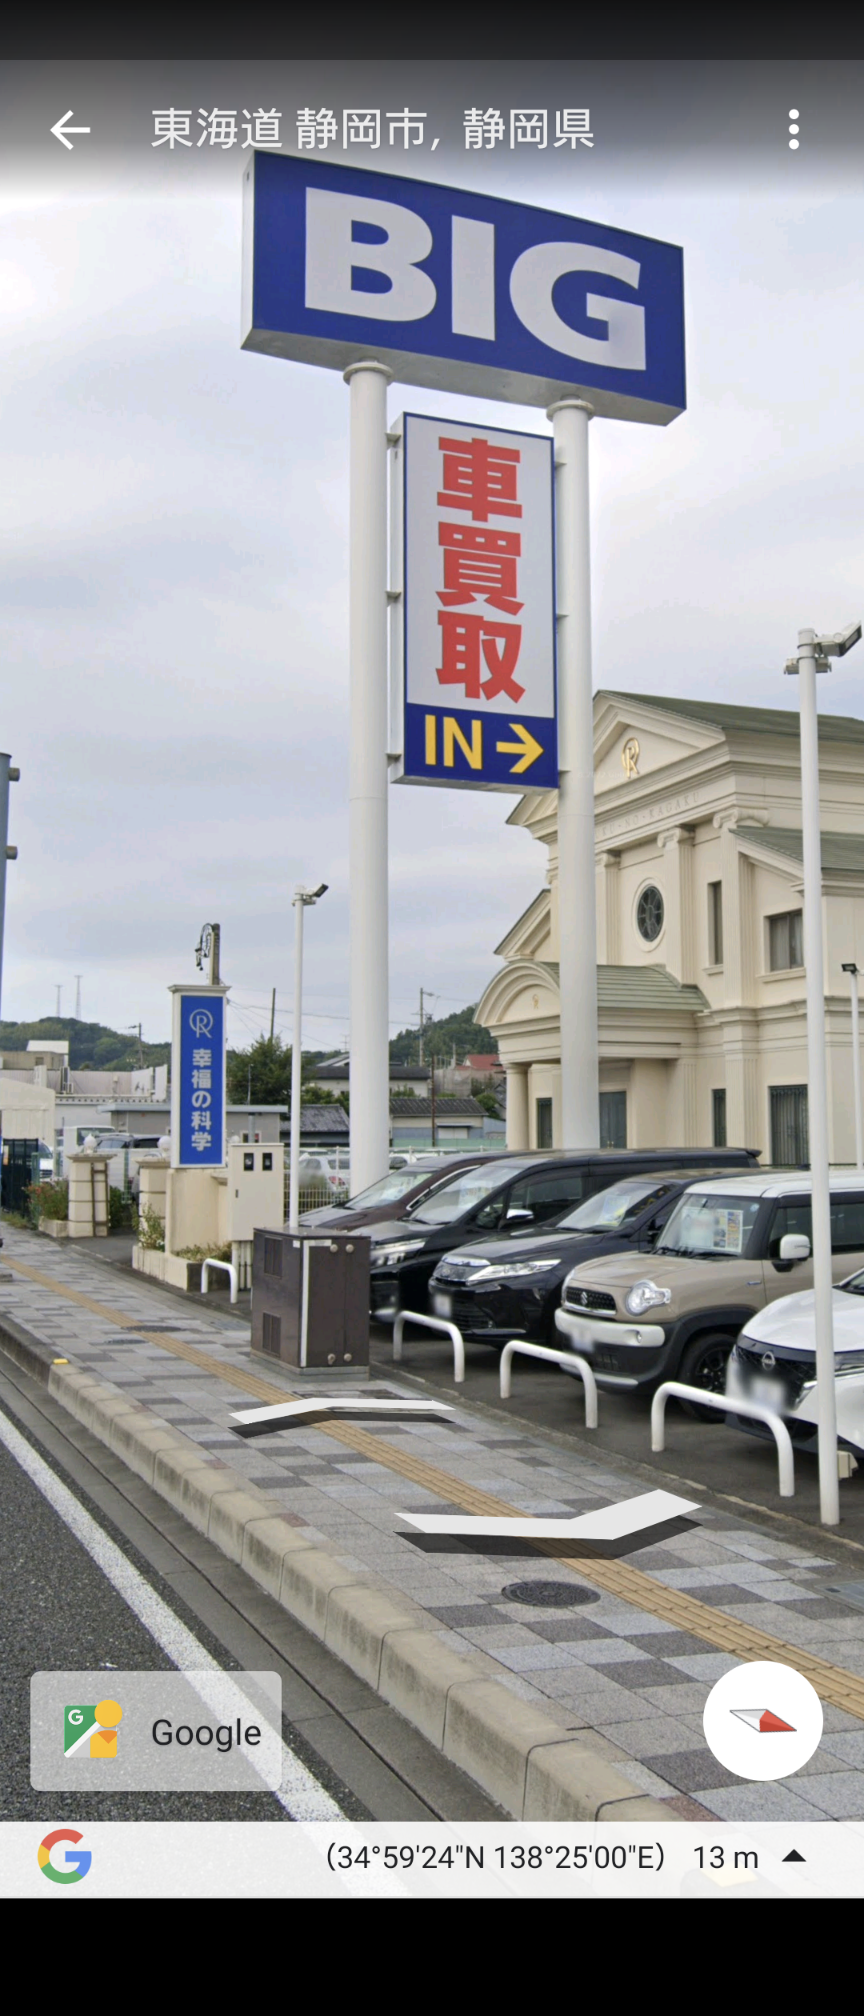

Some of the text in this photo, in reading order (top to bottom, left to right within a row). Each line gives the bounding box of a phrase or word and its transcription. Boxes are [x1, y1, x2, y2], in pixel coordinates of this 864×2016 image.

[304, 186, 647, 372] BIG
[435, 436, 526, 704] 車買取
[425, 714, 483, 770] IN
[191, 1048, 212, 1152] 幸福の科学
